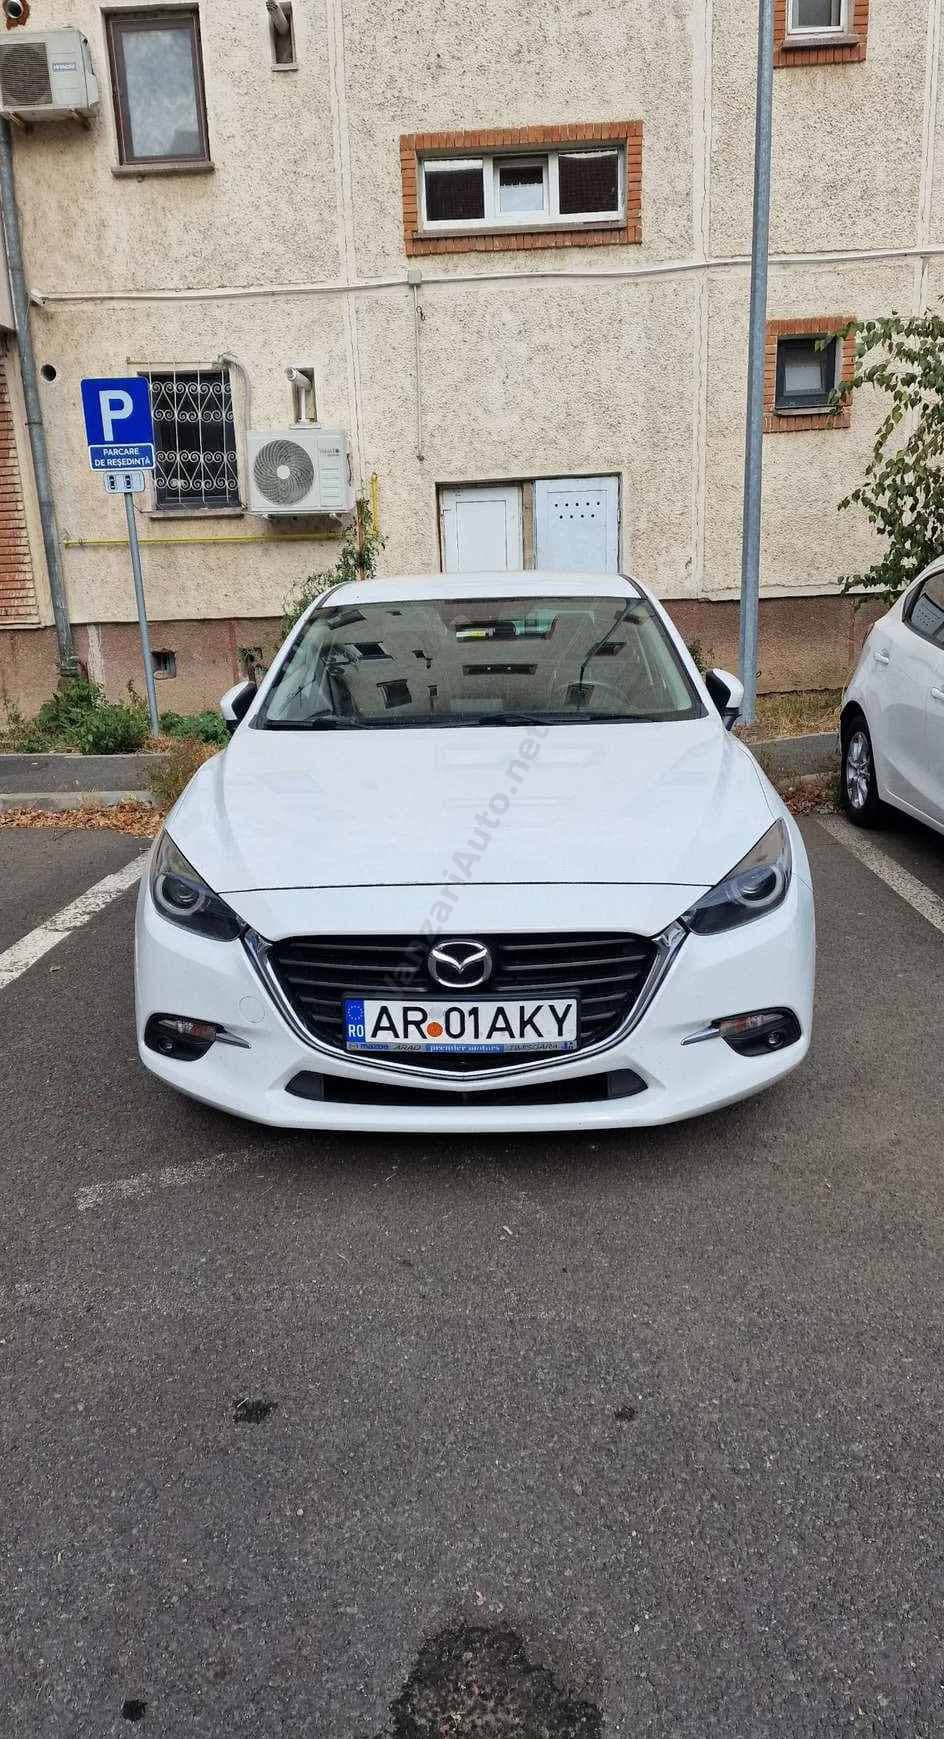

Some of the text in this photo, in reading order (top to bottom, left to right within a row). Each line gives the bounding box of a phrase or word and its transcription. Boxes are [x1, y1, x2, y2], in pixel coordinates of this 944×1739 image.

[99, 390, 133, 441] P
[103, 447, 139, 456] PARCARE
[348, 1024, 364, 1038] RO
